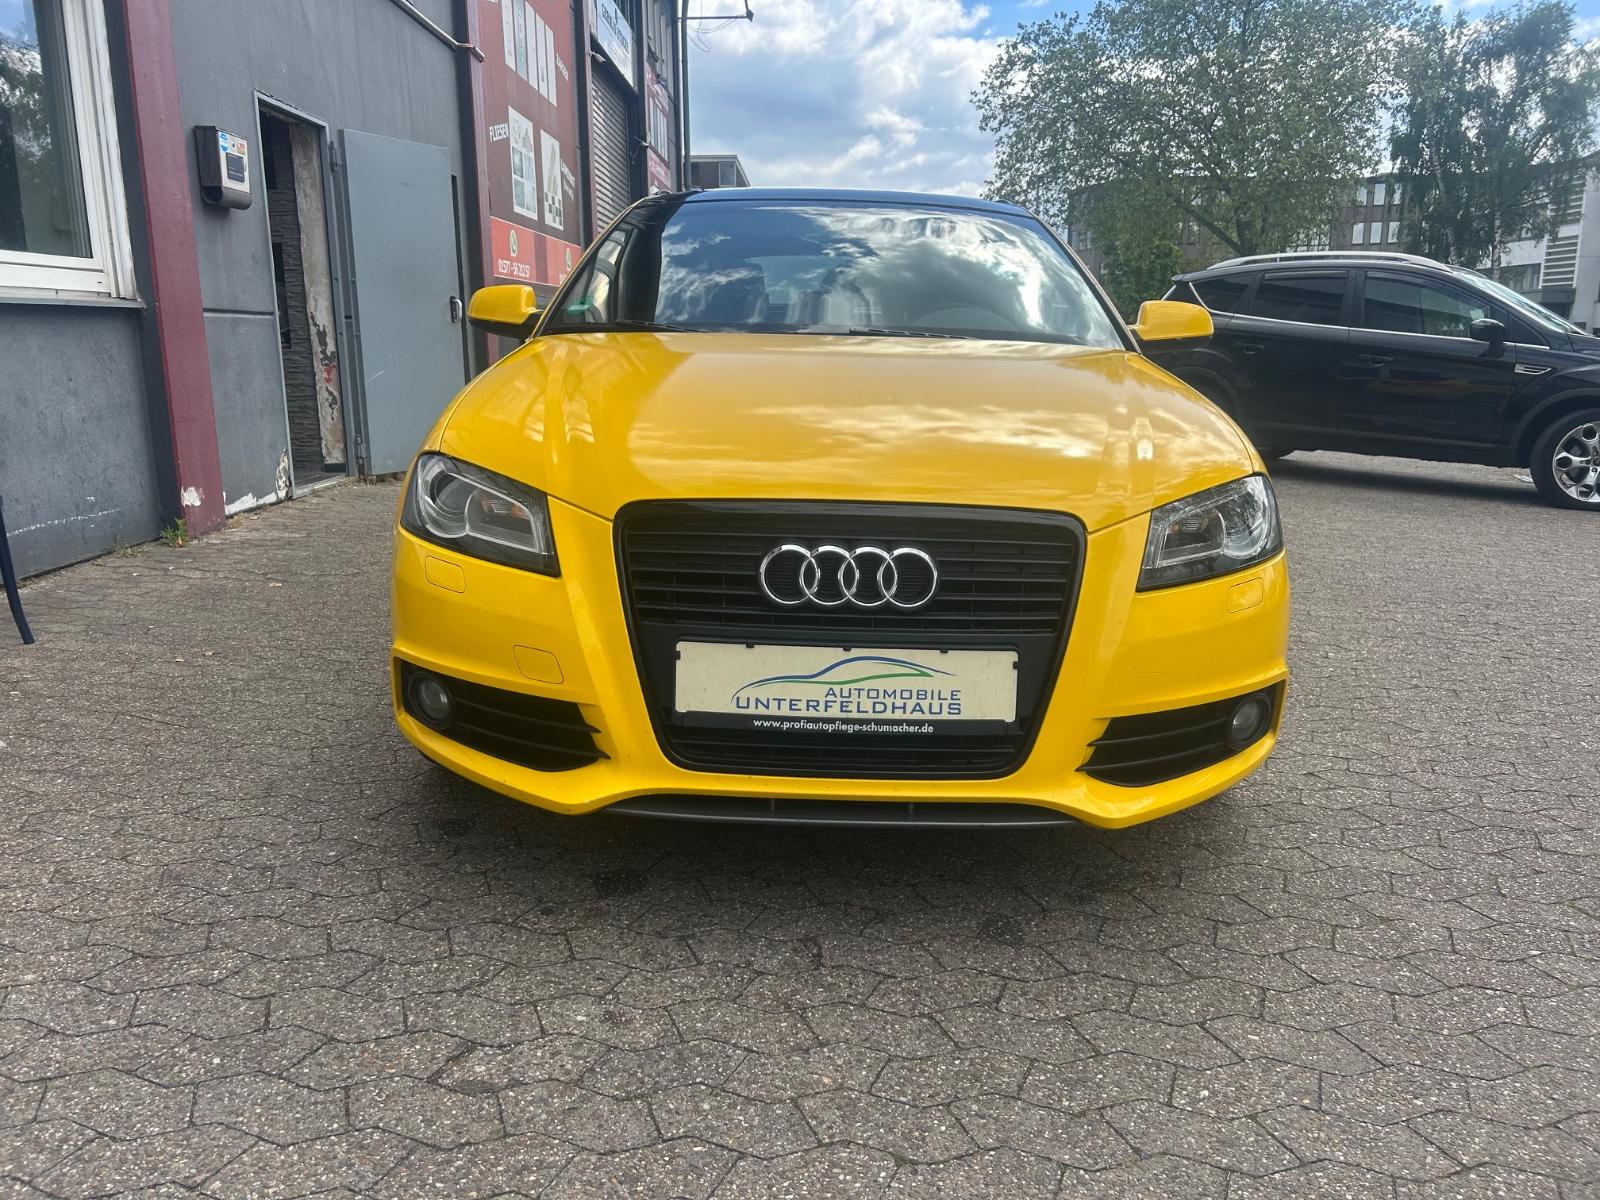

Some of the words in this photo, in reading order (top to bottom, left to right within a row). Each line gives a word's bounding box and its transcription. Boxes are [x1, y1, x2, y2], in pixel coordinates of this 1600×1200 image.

[489, 123, 509, 142] FLIESEN
[825, 687, 962, 702] AUTOMOBILE
[736, 697, 962, 716] UNTERFELDHAUS
[753, 719, 934, 734] www.profiautopflege-schumacher.de
